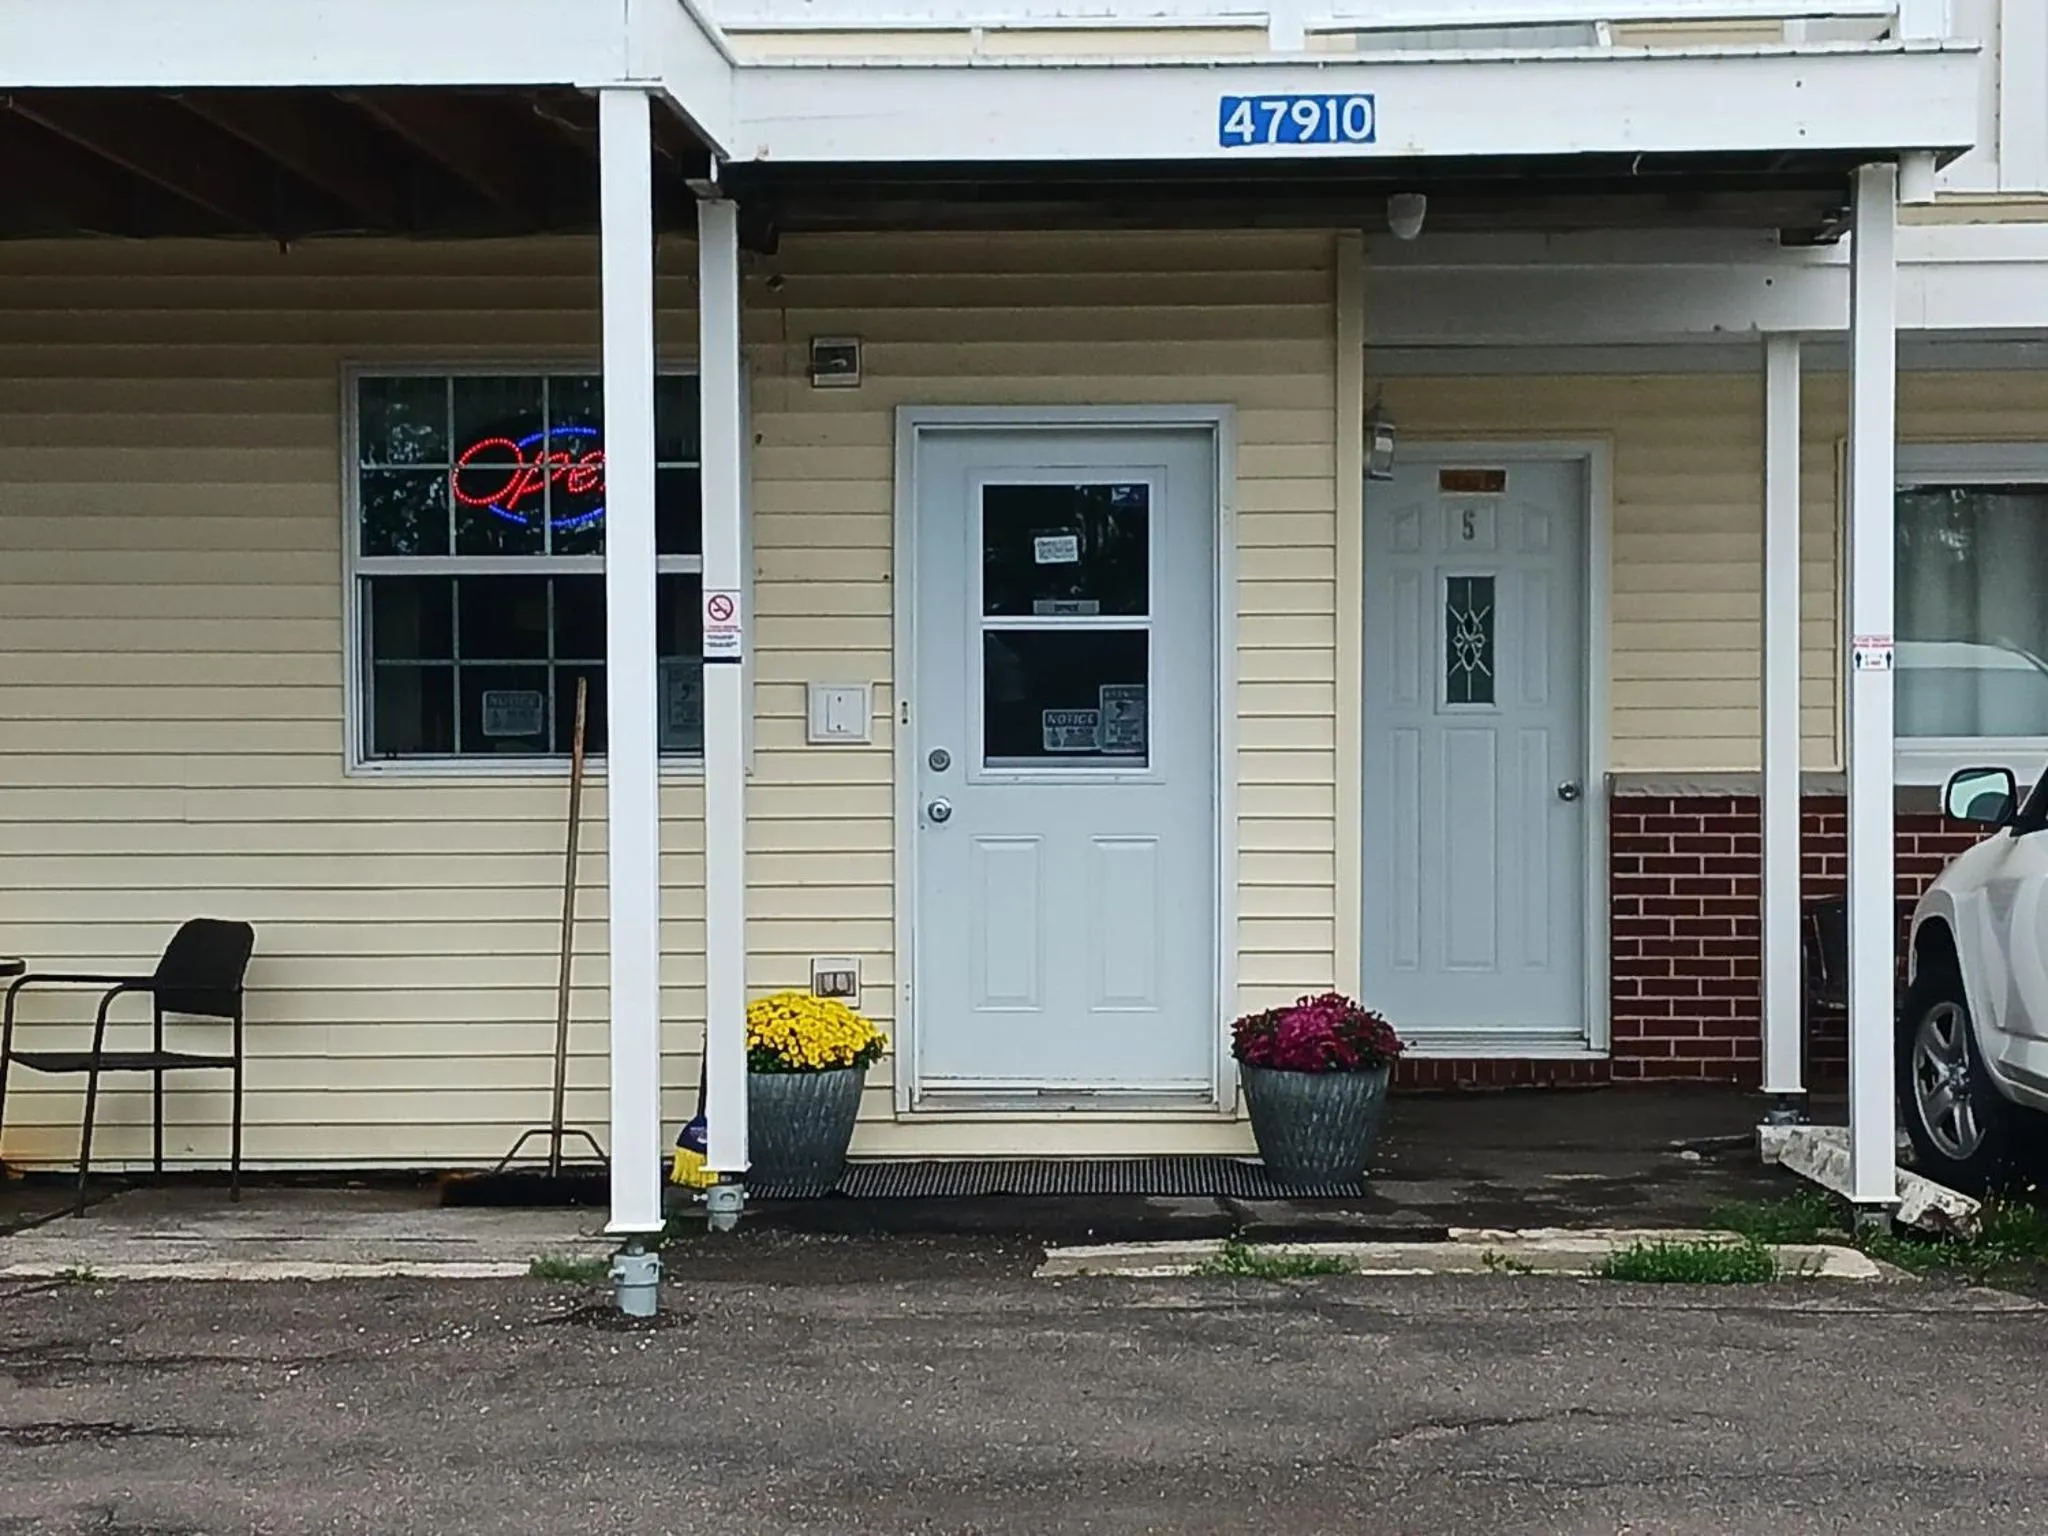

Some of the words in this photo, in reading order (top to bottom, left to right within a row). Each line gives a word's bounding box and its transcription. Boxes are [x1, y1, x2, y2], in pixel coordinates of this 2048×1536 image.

[1224, 97, 1372, 144] 47910
[452, 437, 606, 510] Ope
[1462, 509, 1475, 541] 5
[1047, 713, 1096, 725] NOTICE
